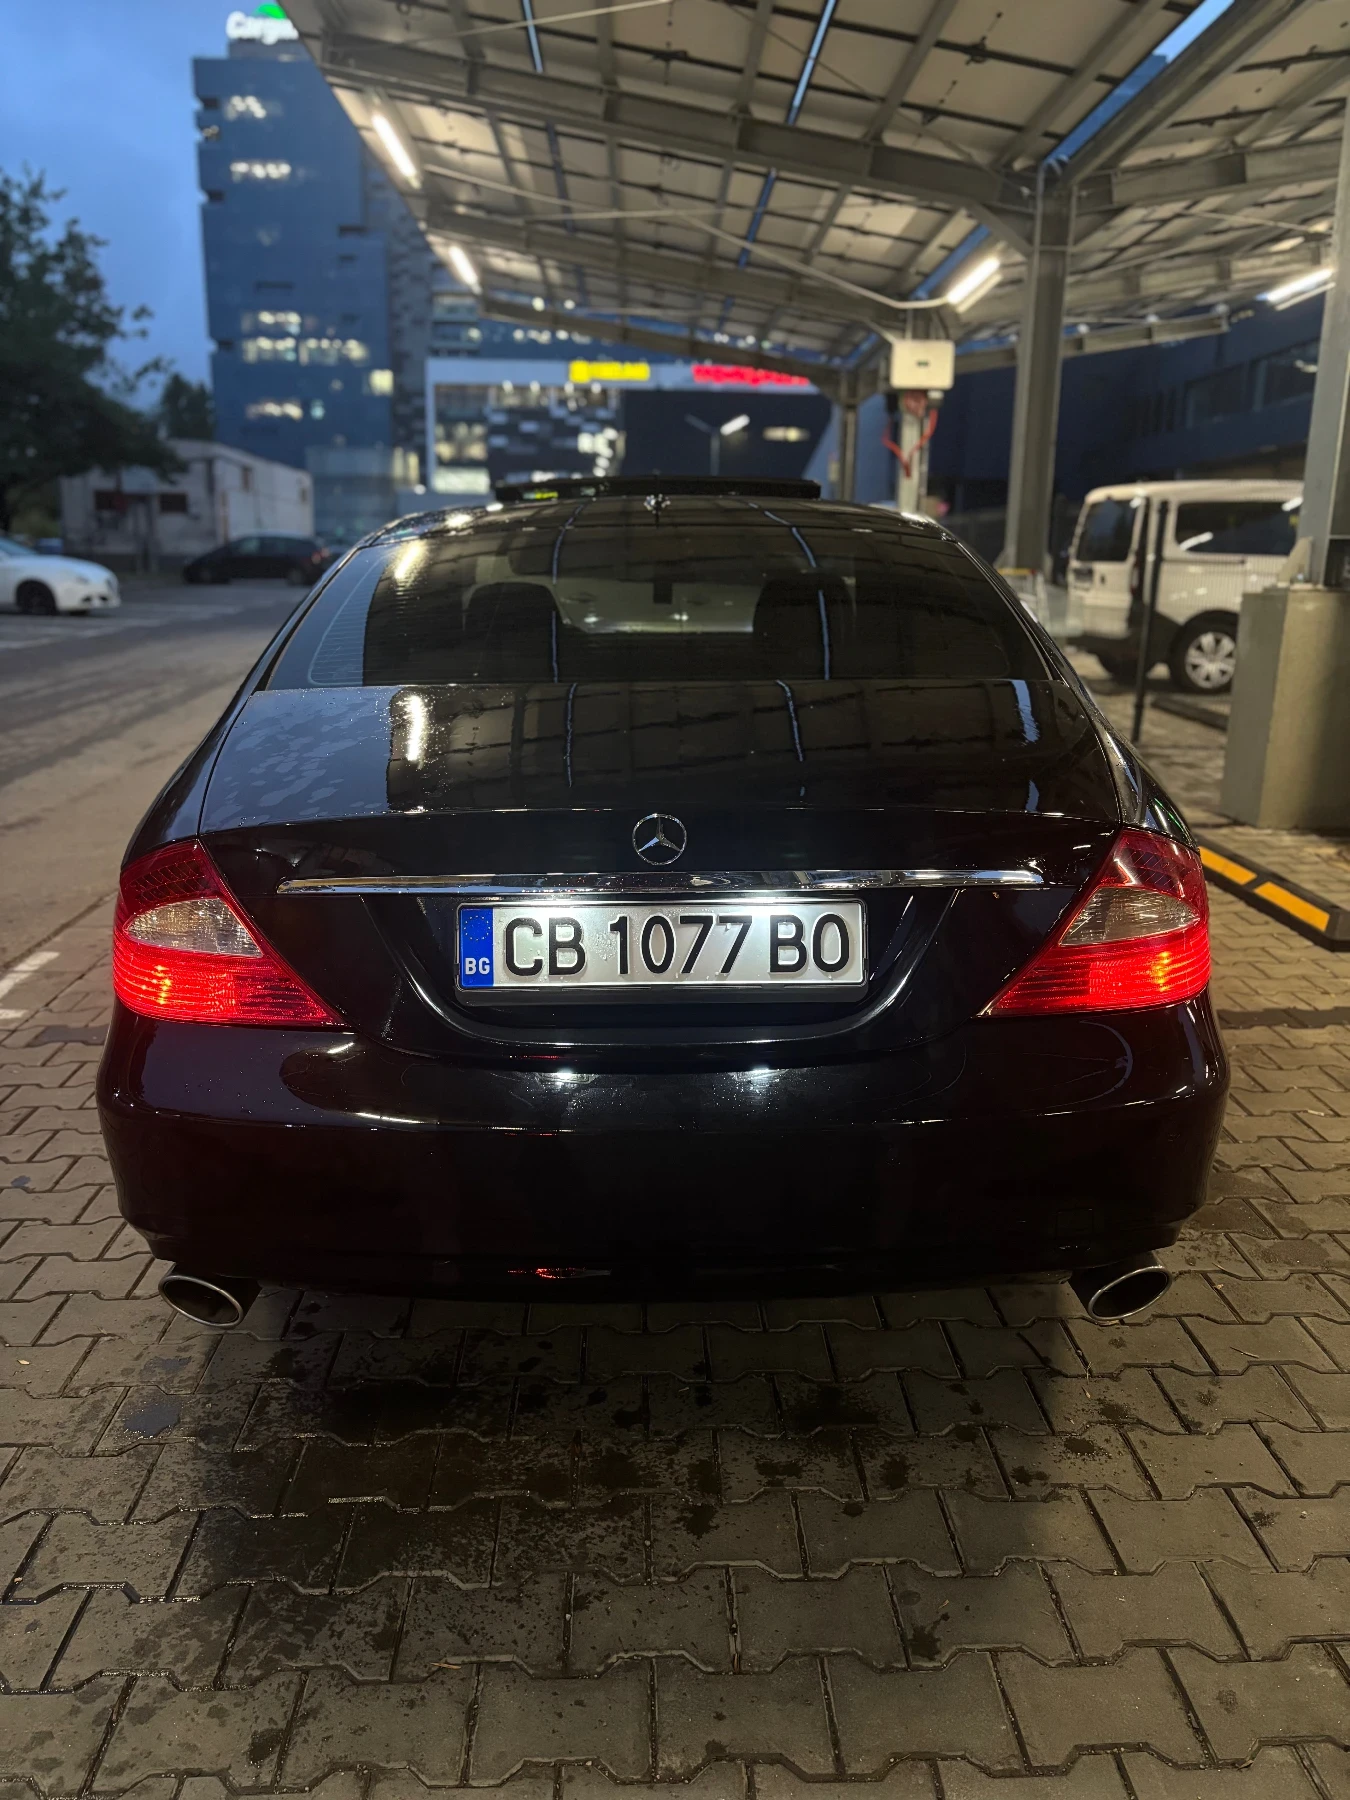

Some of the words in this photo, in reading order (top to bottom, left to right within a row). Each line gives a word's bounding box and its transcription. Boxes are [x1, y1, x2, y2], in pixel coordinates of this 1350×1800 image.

[506, 917, 587, 976] CB
[609, 915, 752, 975] 1077
[465, 957, 491, 975] BG
